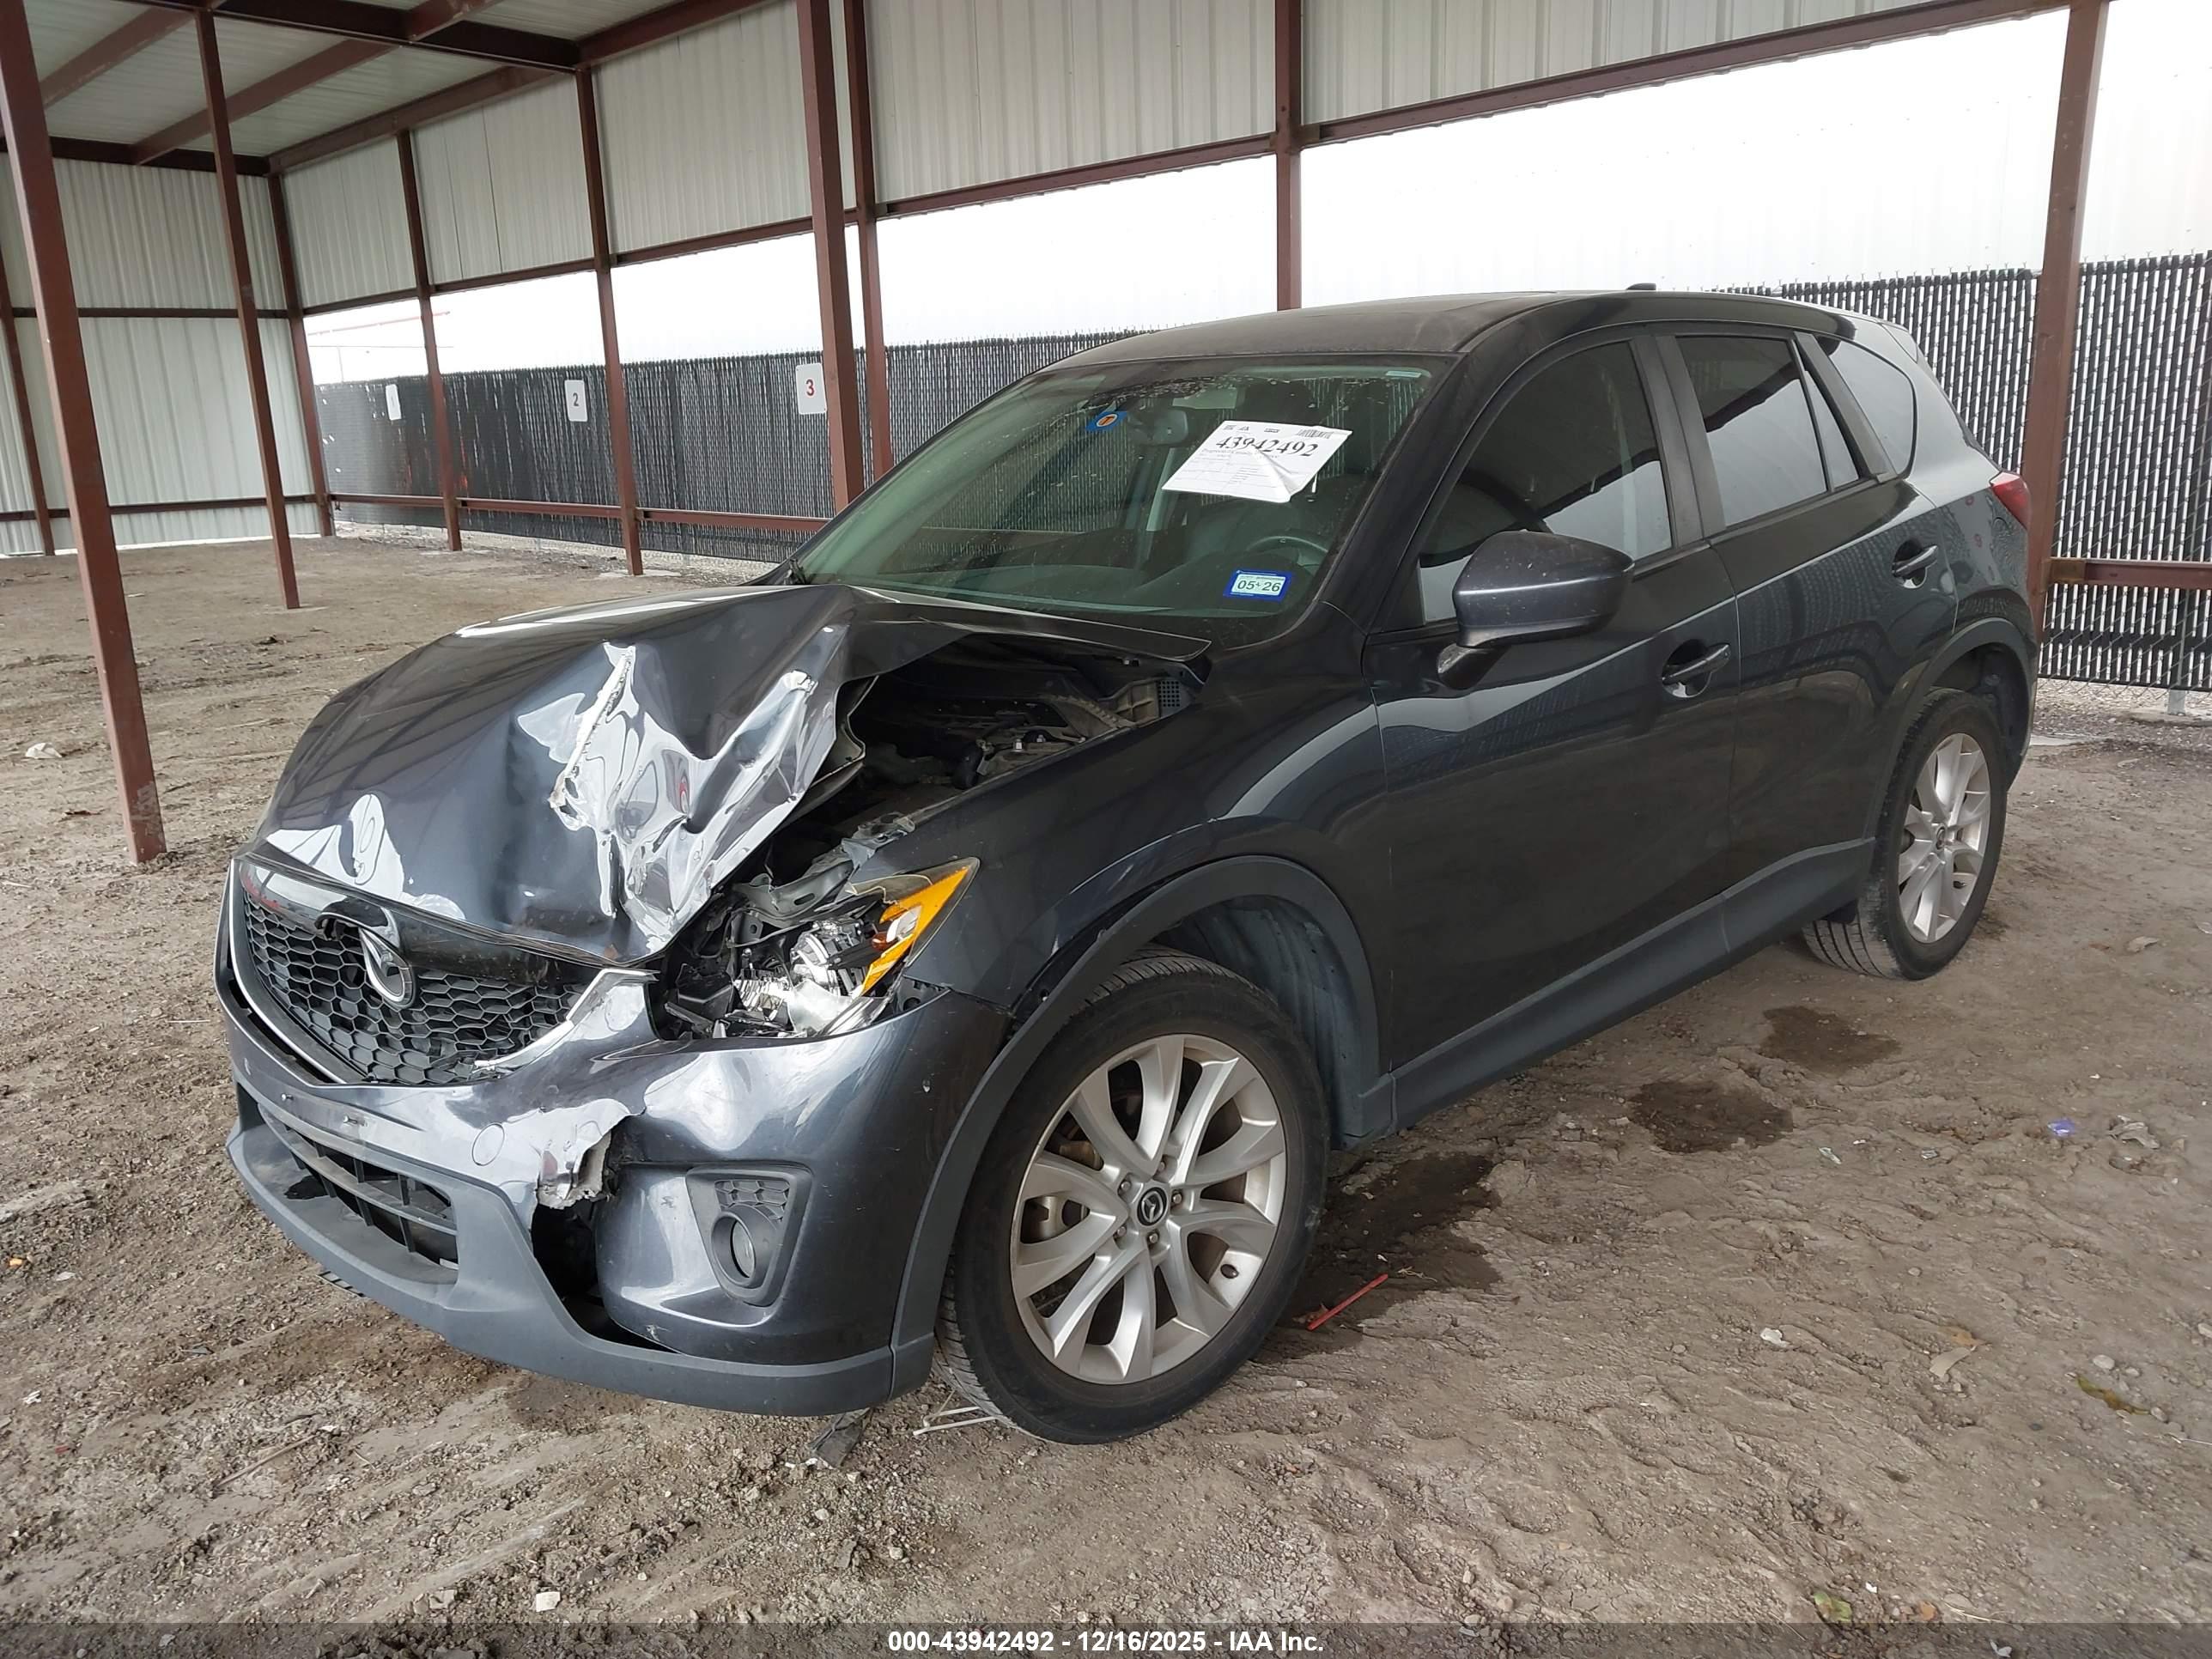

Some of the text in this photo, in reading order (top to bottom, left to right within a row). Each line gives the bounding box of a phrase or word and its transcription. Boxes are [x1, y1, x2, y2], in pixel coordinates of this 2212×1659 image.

[805, 379, 815, 396] 3
[573, 392, 580, 406] 2
[1215, 436, 1319, 457] 43942492
[1237, 580, 1281, 592] 05 26
